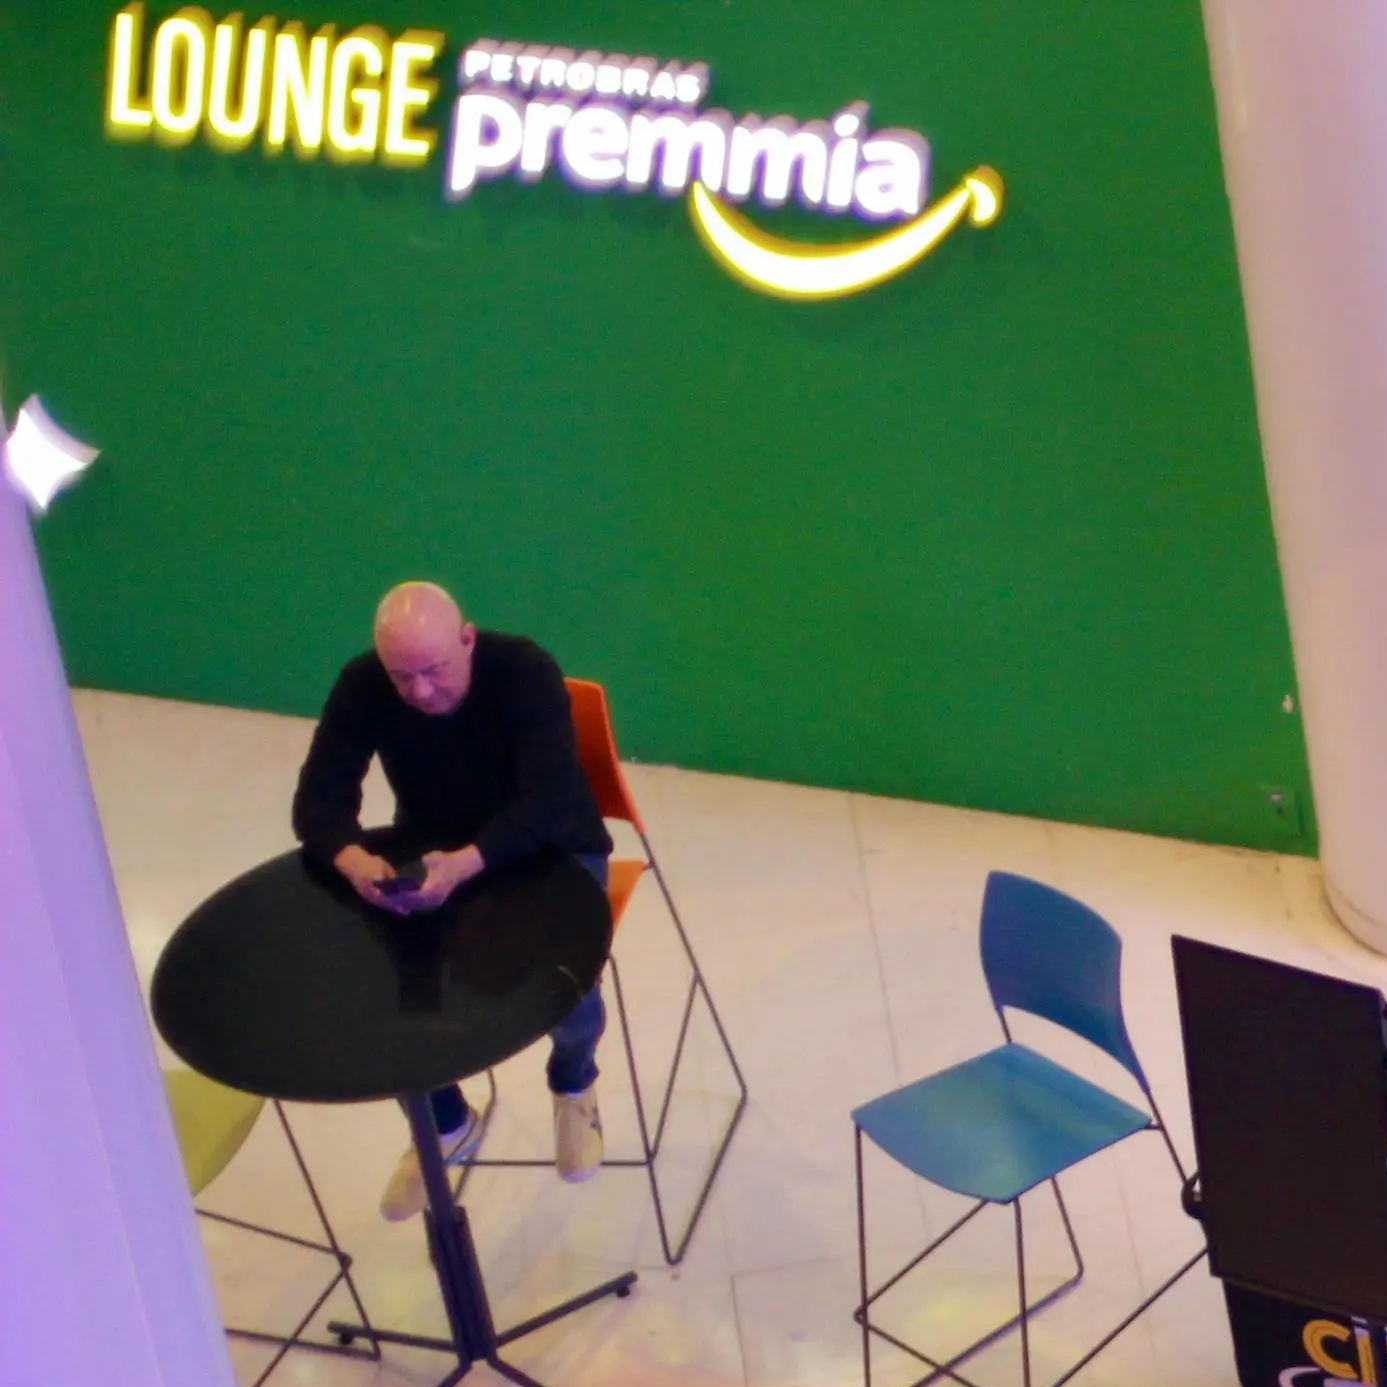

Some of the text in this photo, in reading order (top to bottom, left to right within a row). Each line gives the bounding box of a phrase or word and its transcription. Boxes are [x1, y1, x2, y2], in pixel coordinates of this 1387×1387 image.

[109, 9, 436, 159] LOUNGE
[463, 46, 704, 104] PETROBRAS
[450, 94, 925, 216] premmia
